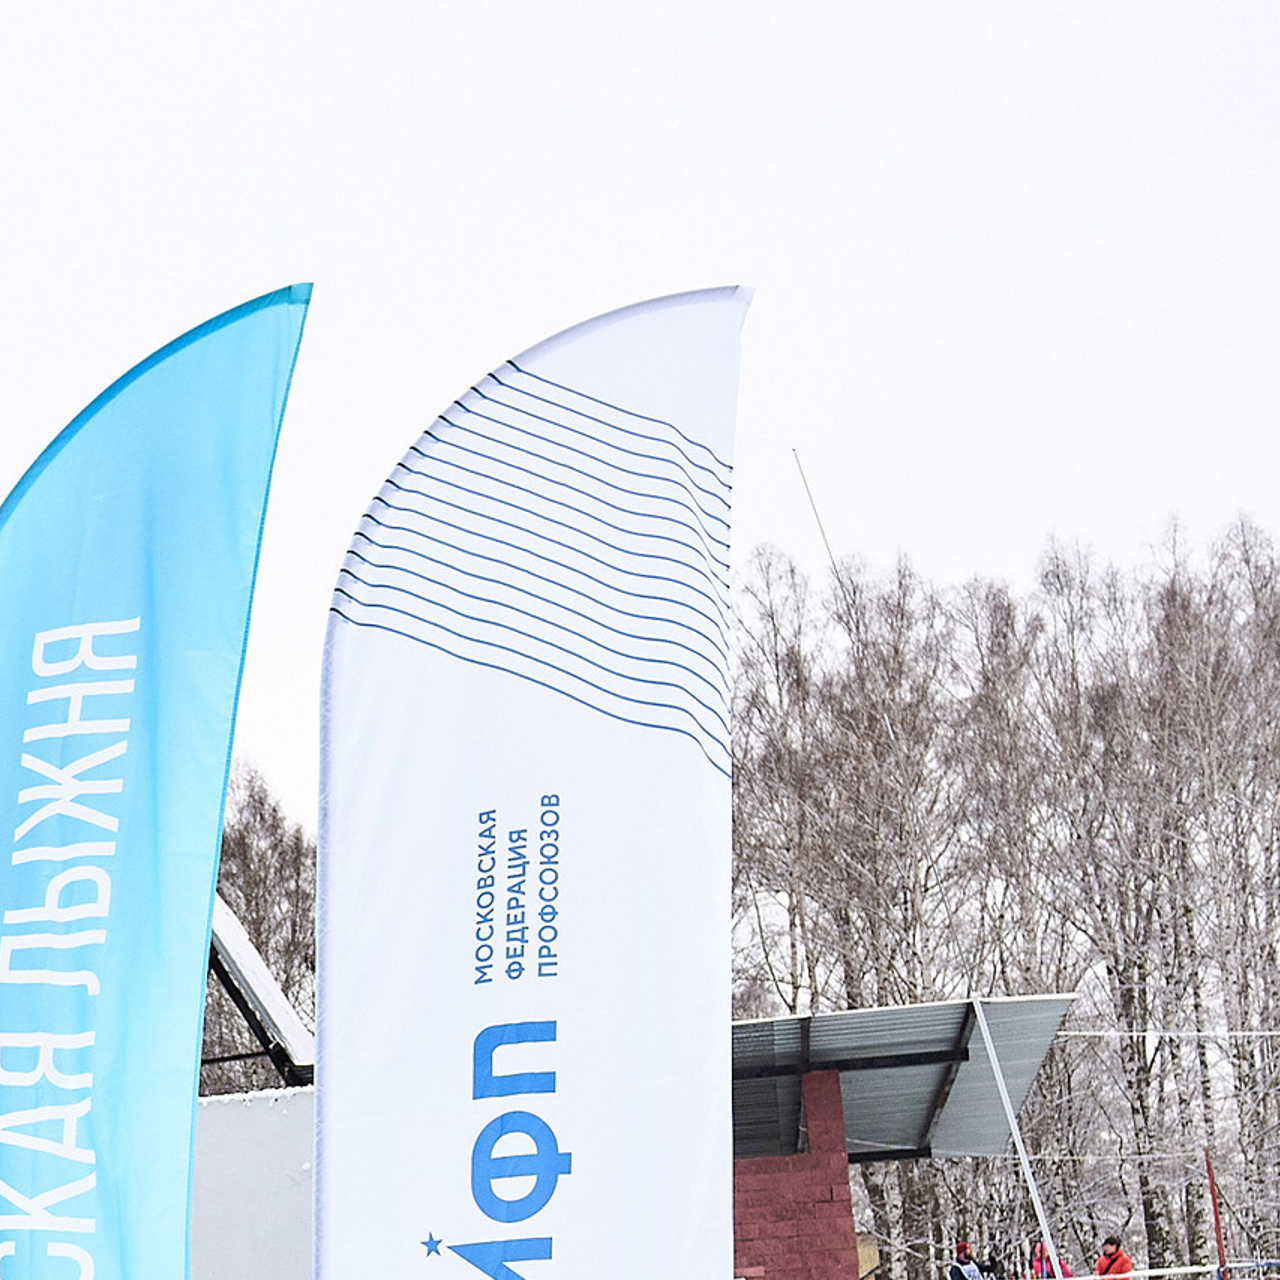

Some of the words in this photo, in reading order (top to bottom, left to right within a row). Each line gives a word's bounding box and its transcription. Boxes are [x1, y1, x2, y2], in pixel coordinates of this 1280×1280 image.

[473, 809, 497, 985] МОСКОВСКАЯ
[505, 828, 530, 981] ФЕДЕРАЦИЯ
[537, 793, 561, 978] ПРОФСОЮЗОВ
